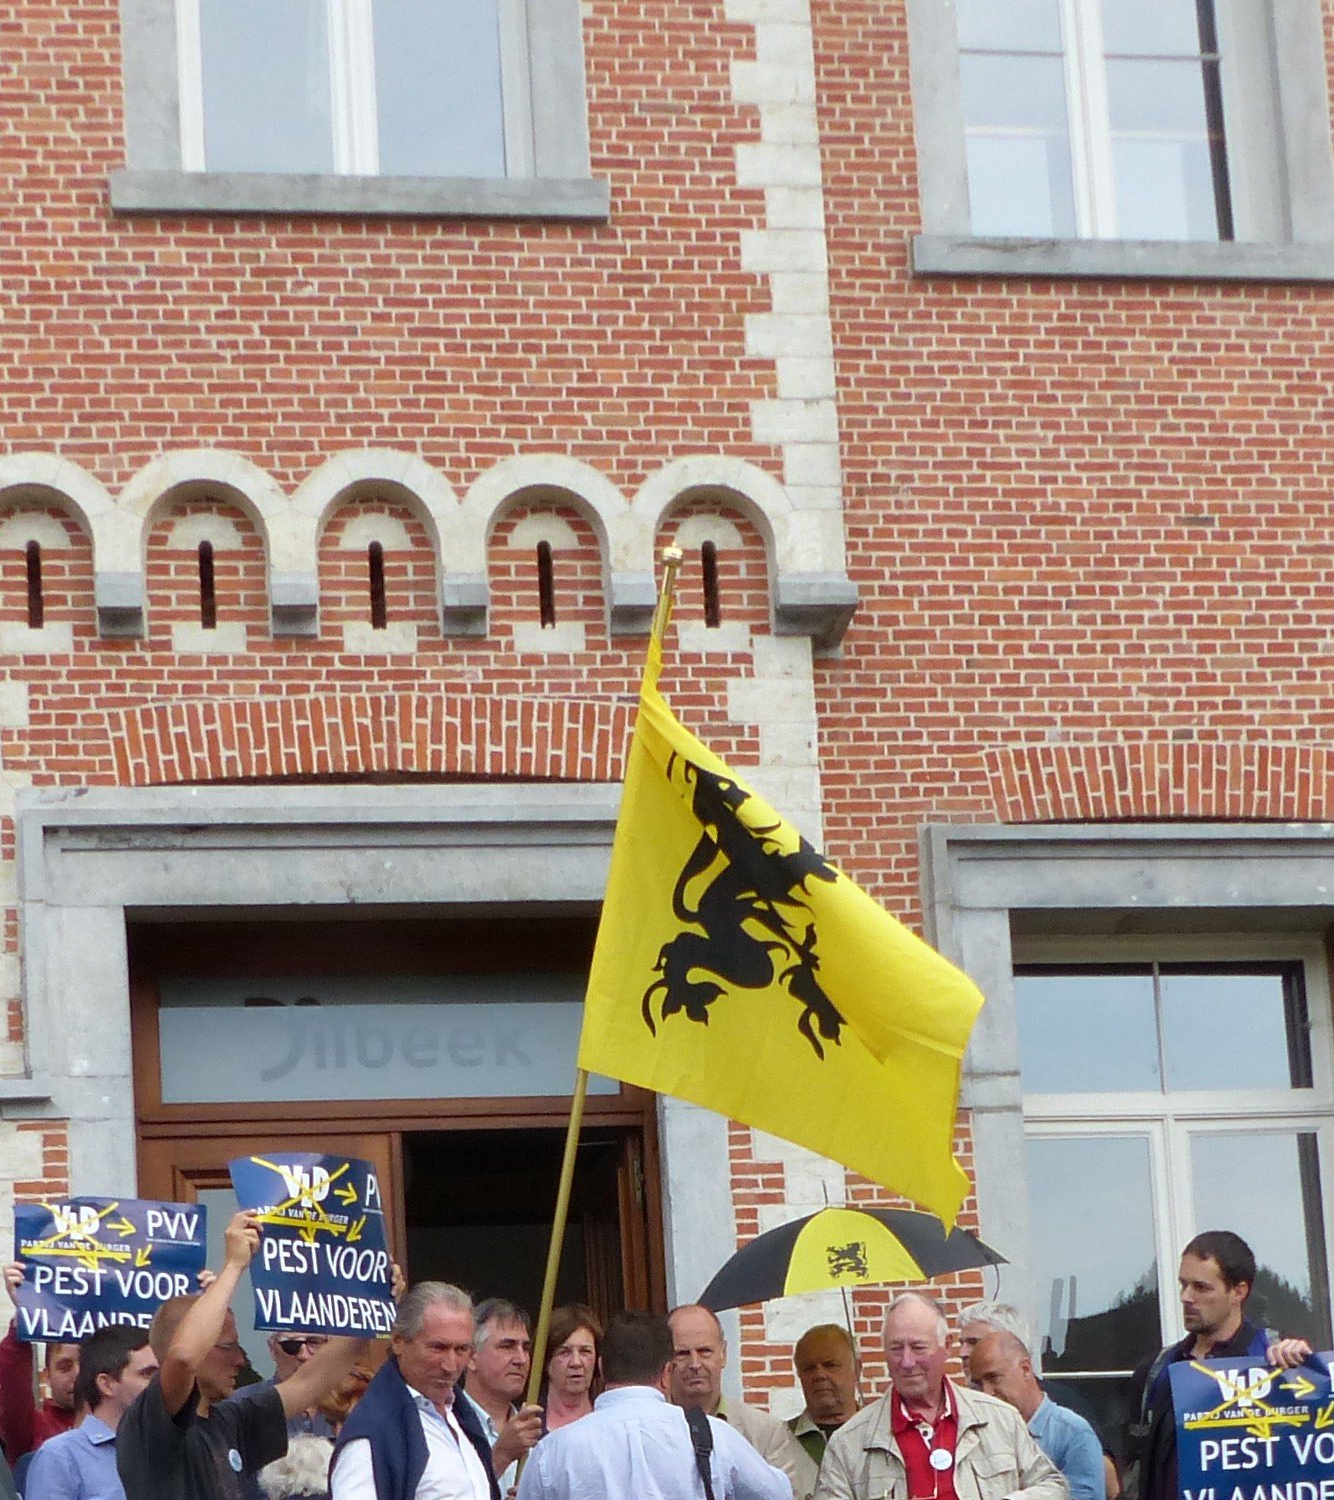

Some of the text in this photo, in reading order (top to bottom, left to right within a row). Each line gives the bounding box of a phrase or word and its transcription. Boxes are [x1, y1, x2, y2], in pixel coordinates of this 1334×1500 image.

[147, 1210, 198, 1241] PVV
[263, 1238, 388, 1284] PEST VOOR
[34, 1266, 189, 1300] PEST VOOR
[256, 1288, 397, 1332] VLAANDEREN
[1224, 1409, 1244, 1418] VAN
[1200, 1436, 1280, 1471] PEST
